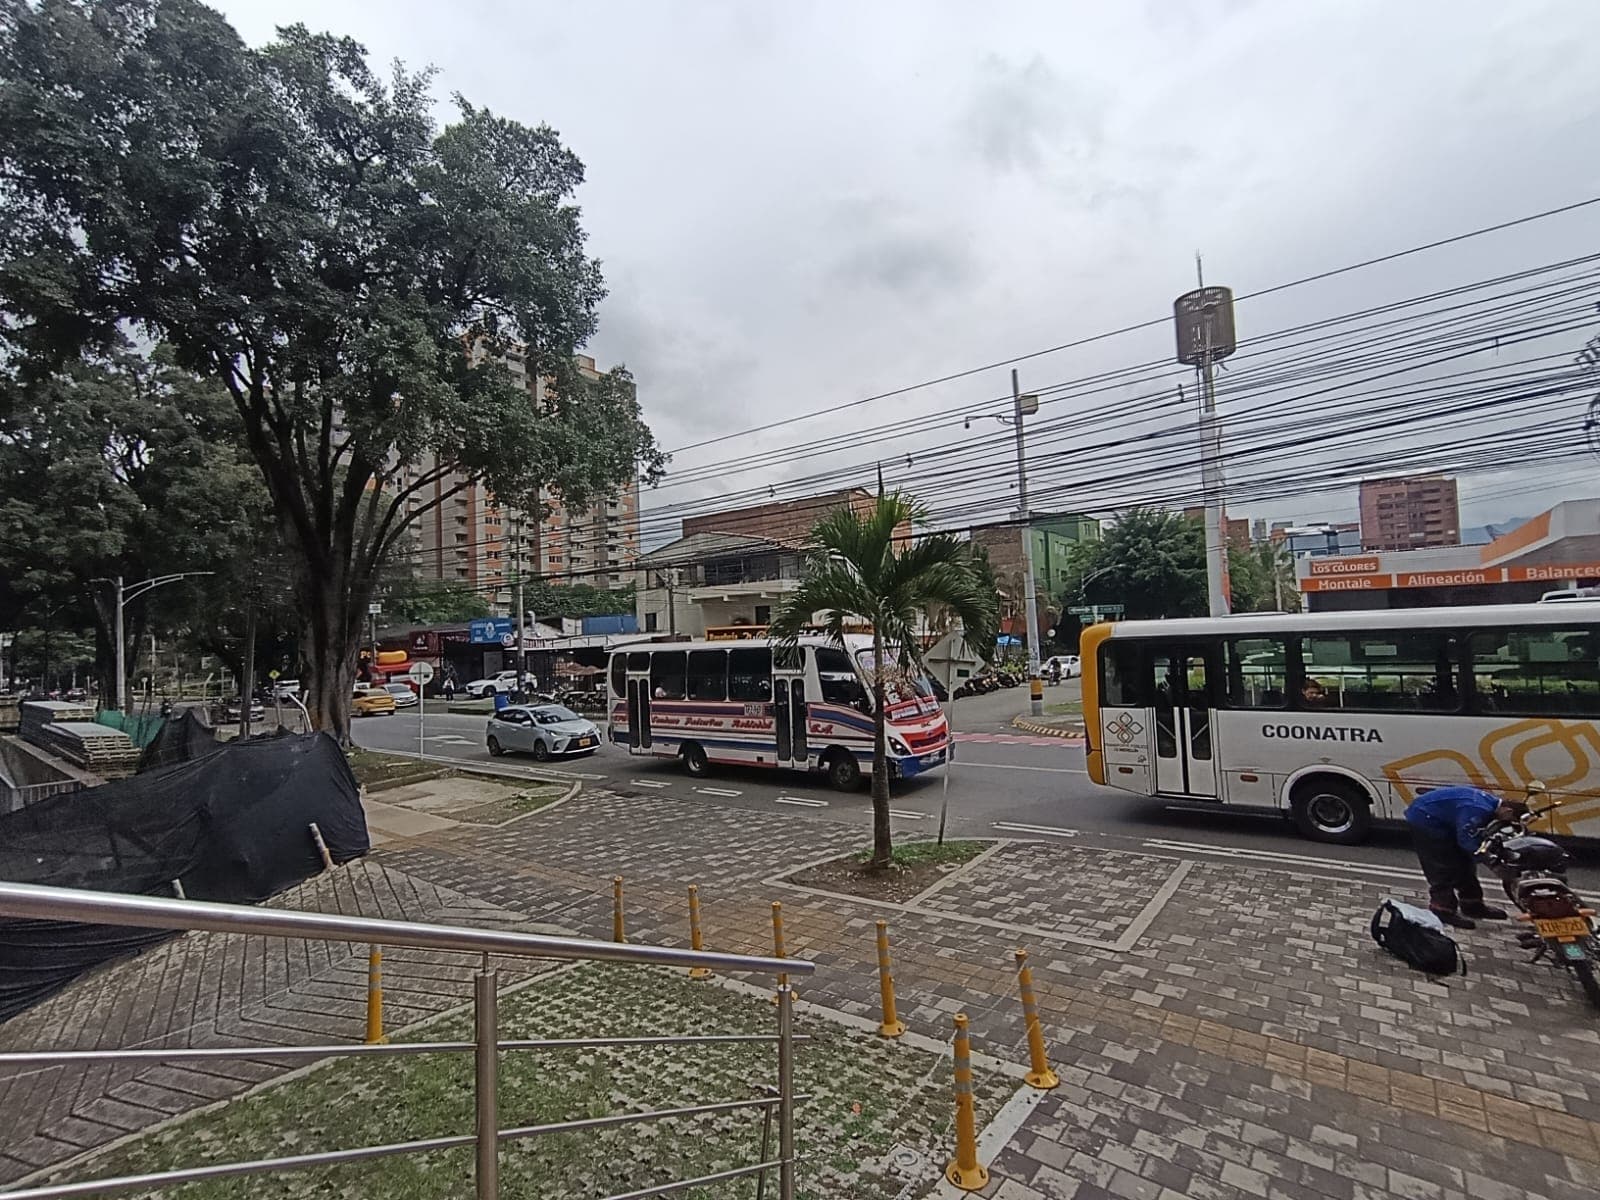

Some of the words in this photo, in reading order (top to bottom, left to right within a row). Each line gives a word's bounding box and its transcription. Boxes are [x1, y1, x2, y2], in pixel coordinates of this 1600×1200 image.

[1312, 565, 1330, 574] LOS
[1332, 562, 1377, 573] COLORES
[1407, 572, 1485, 586] Alineación
[1262, 725, 1384, 743] COONATRA
